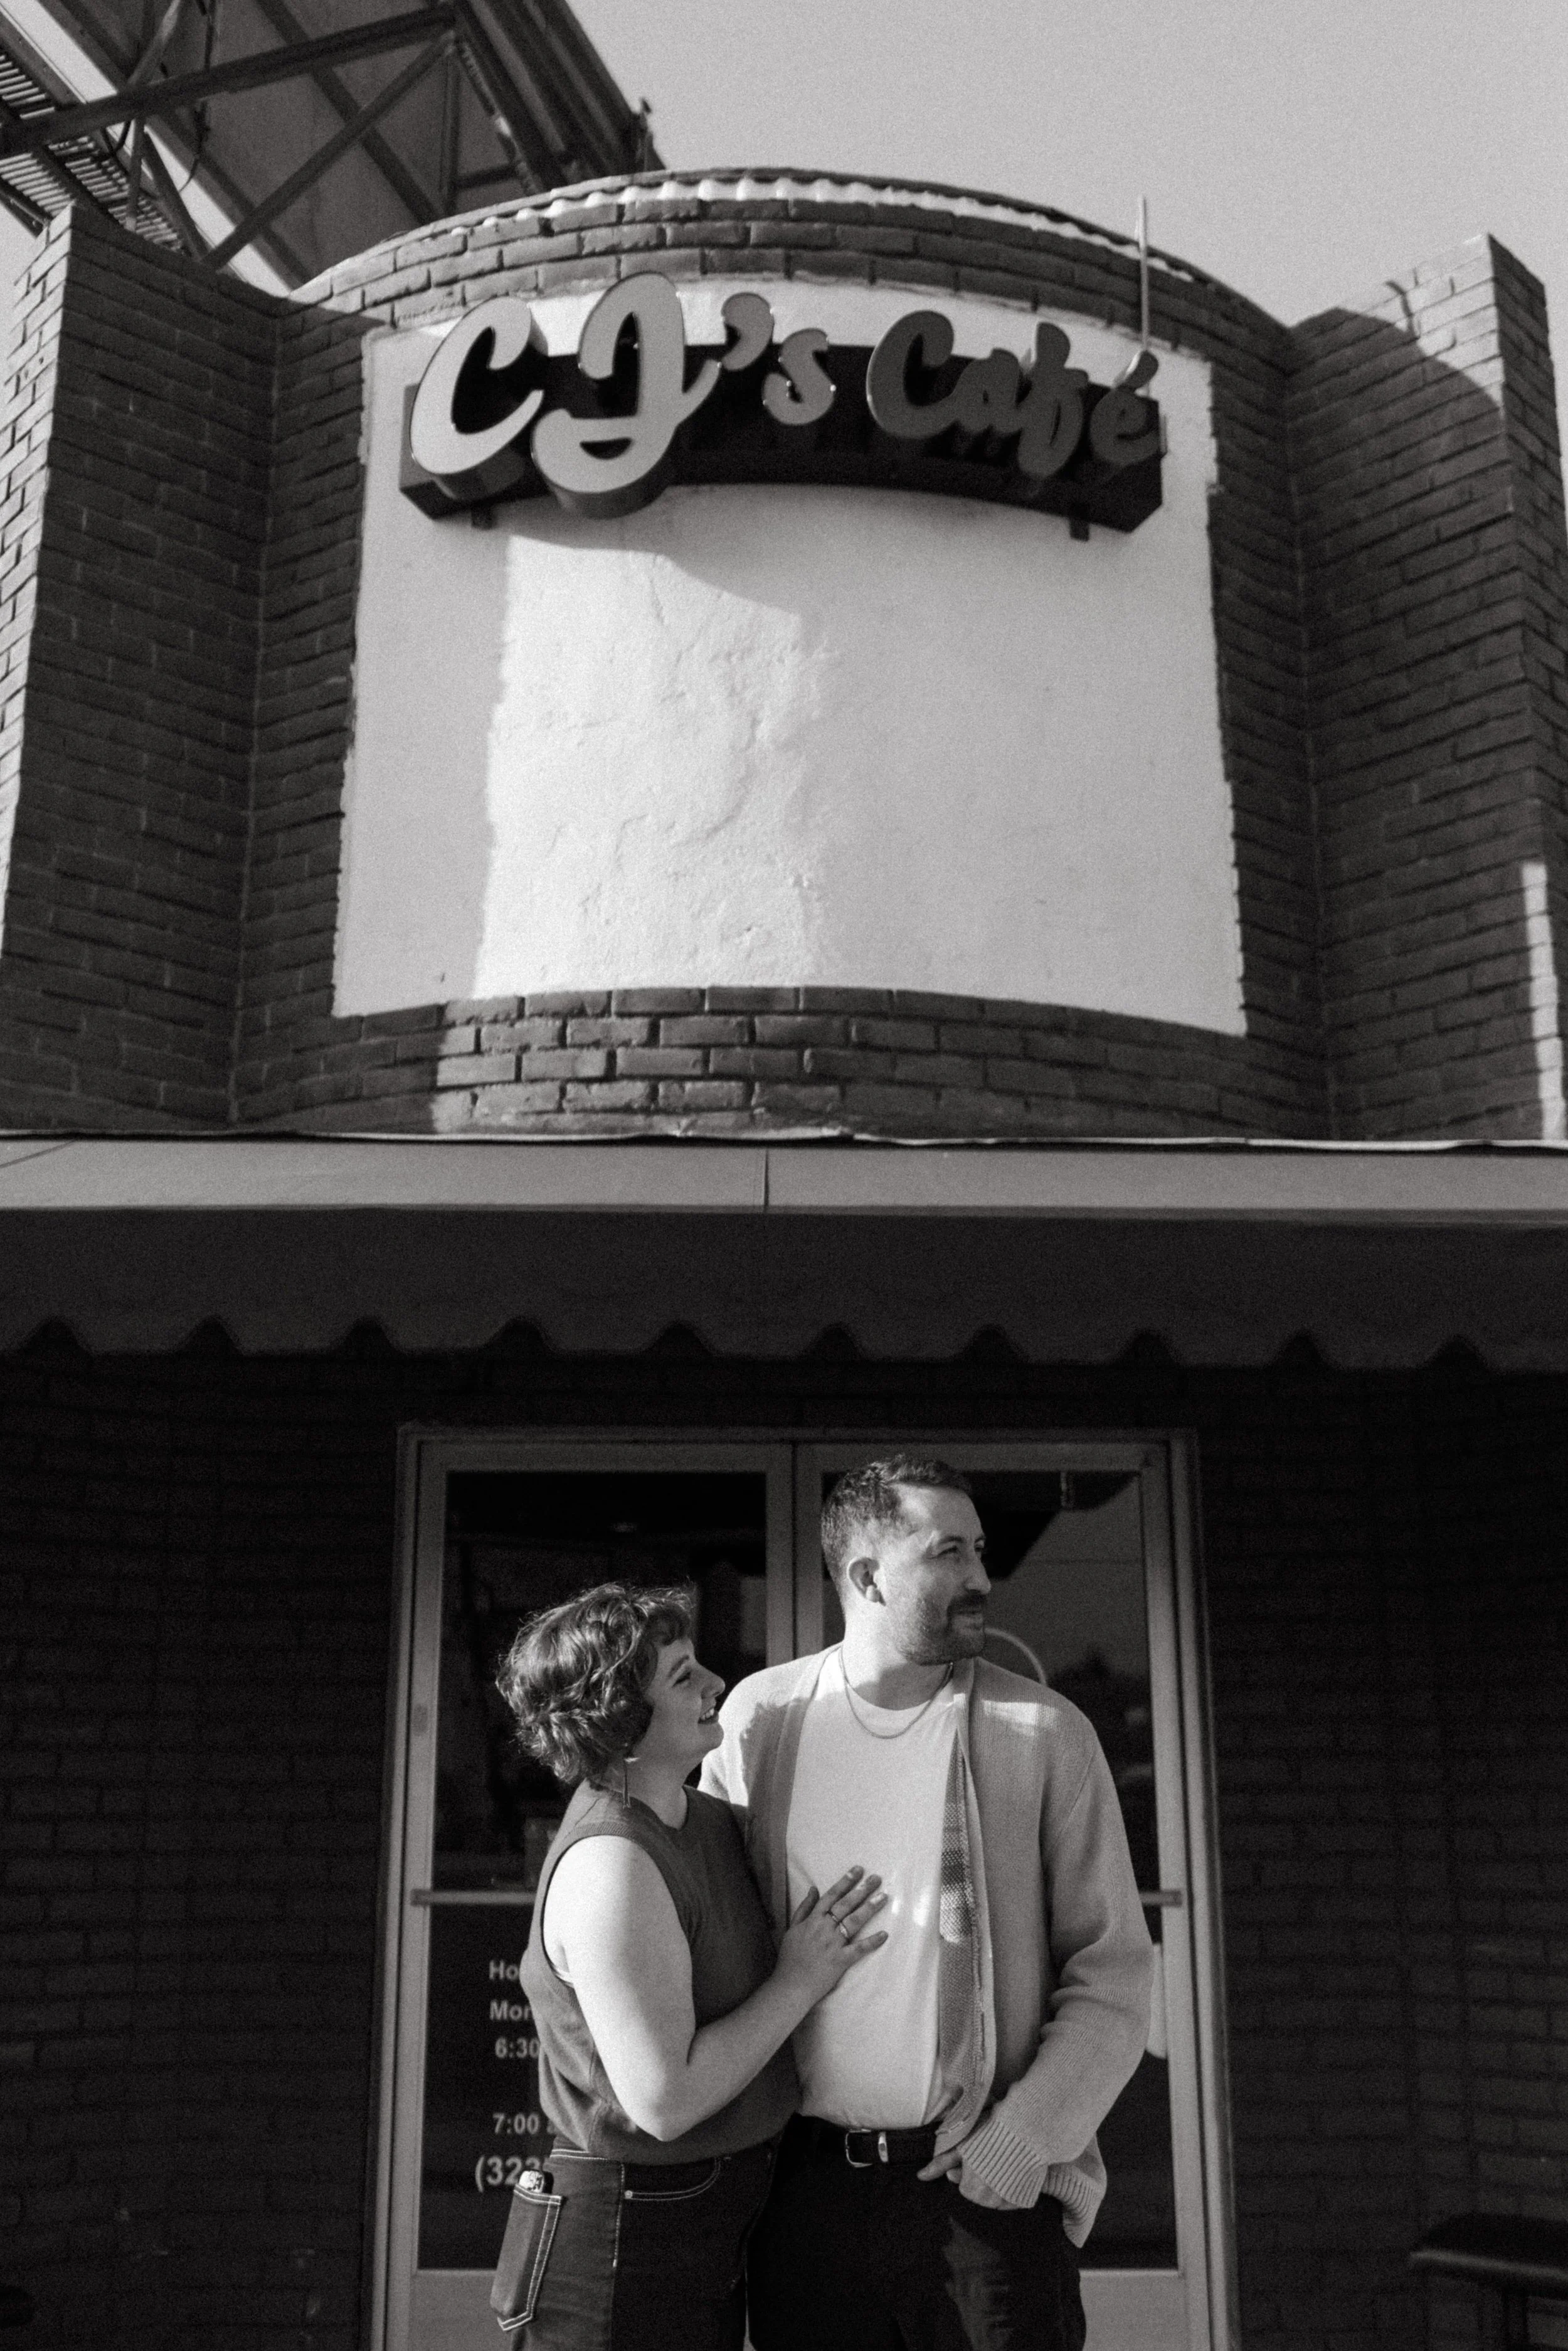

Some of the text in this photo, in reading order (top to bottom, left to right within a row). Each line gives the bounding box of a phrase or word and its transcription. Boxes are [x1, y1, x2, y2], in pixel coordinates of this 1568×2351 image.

[409, 270, 1159, 494] CJ's Café
[495, 2037, 540, 2058] 6:30
[492, 2112, 539, 2134] 7:00
